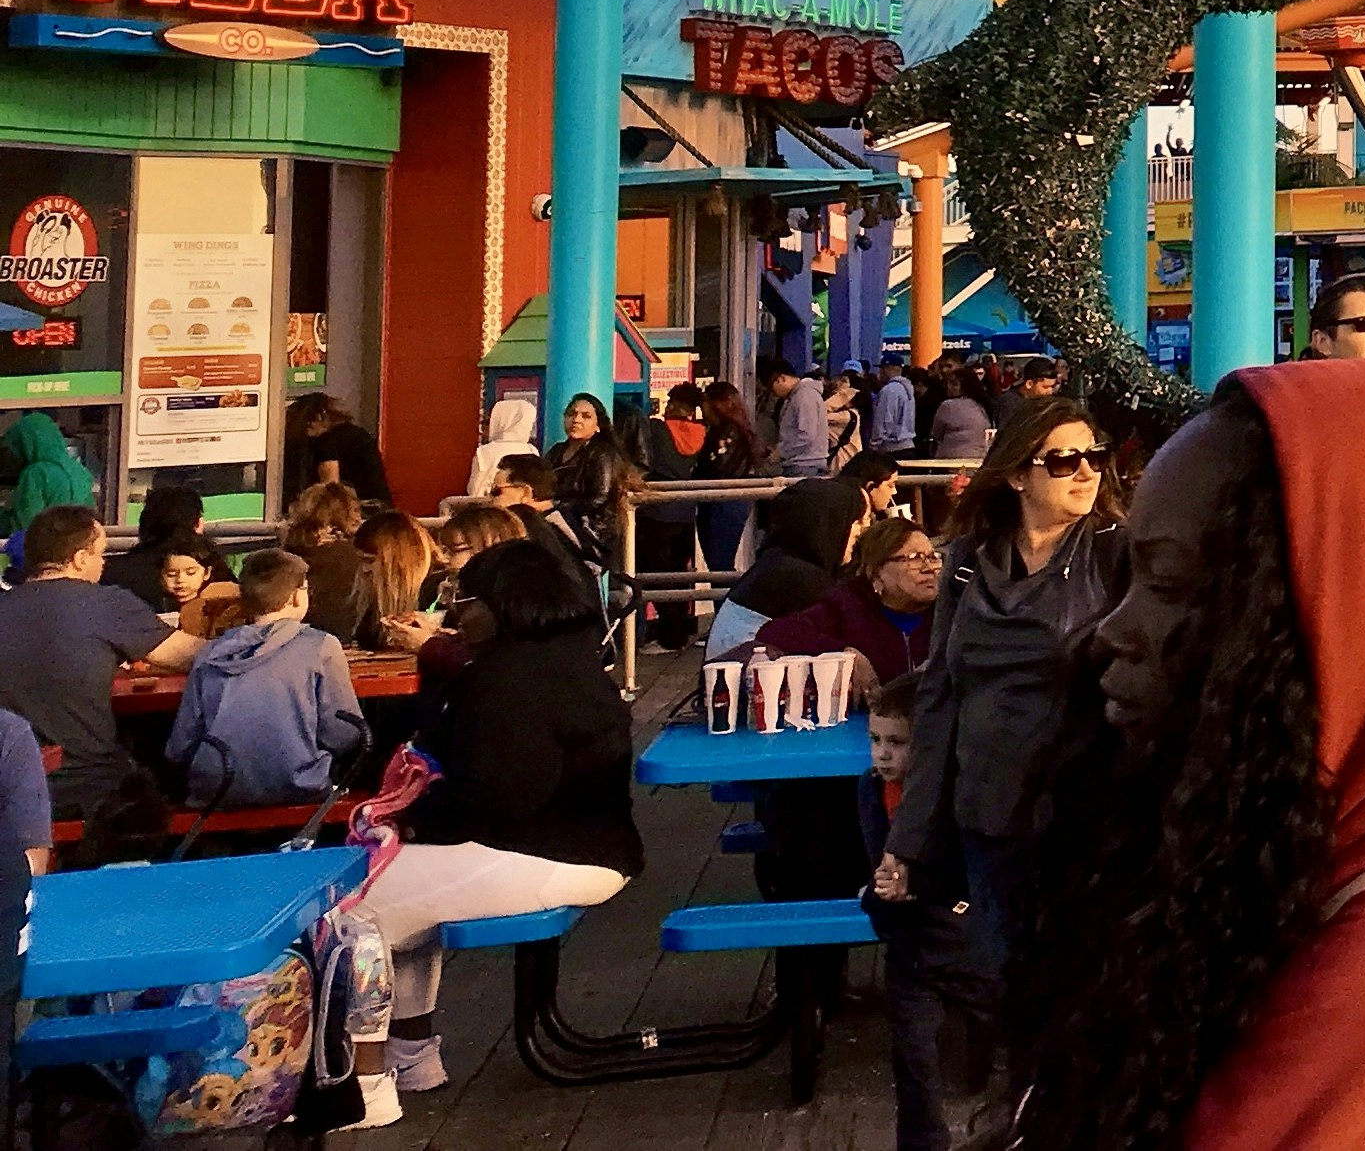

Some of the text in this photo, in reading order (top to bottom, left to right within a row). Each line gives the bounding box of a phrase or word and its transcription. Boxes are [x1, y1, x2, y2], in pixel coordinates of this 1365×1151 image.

[218, 26, 274, 56] CO.
[682, 17, 905, 106] TACOS
[25, 198, 89, 224] GENUINE
[173, 240, 239, 250] WING DINGS
[0, 256, 108, 282] BROASTER
[26, 280, 83, 303] CHICKEN
